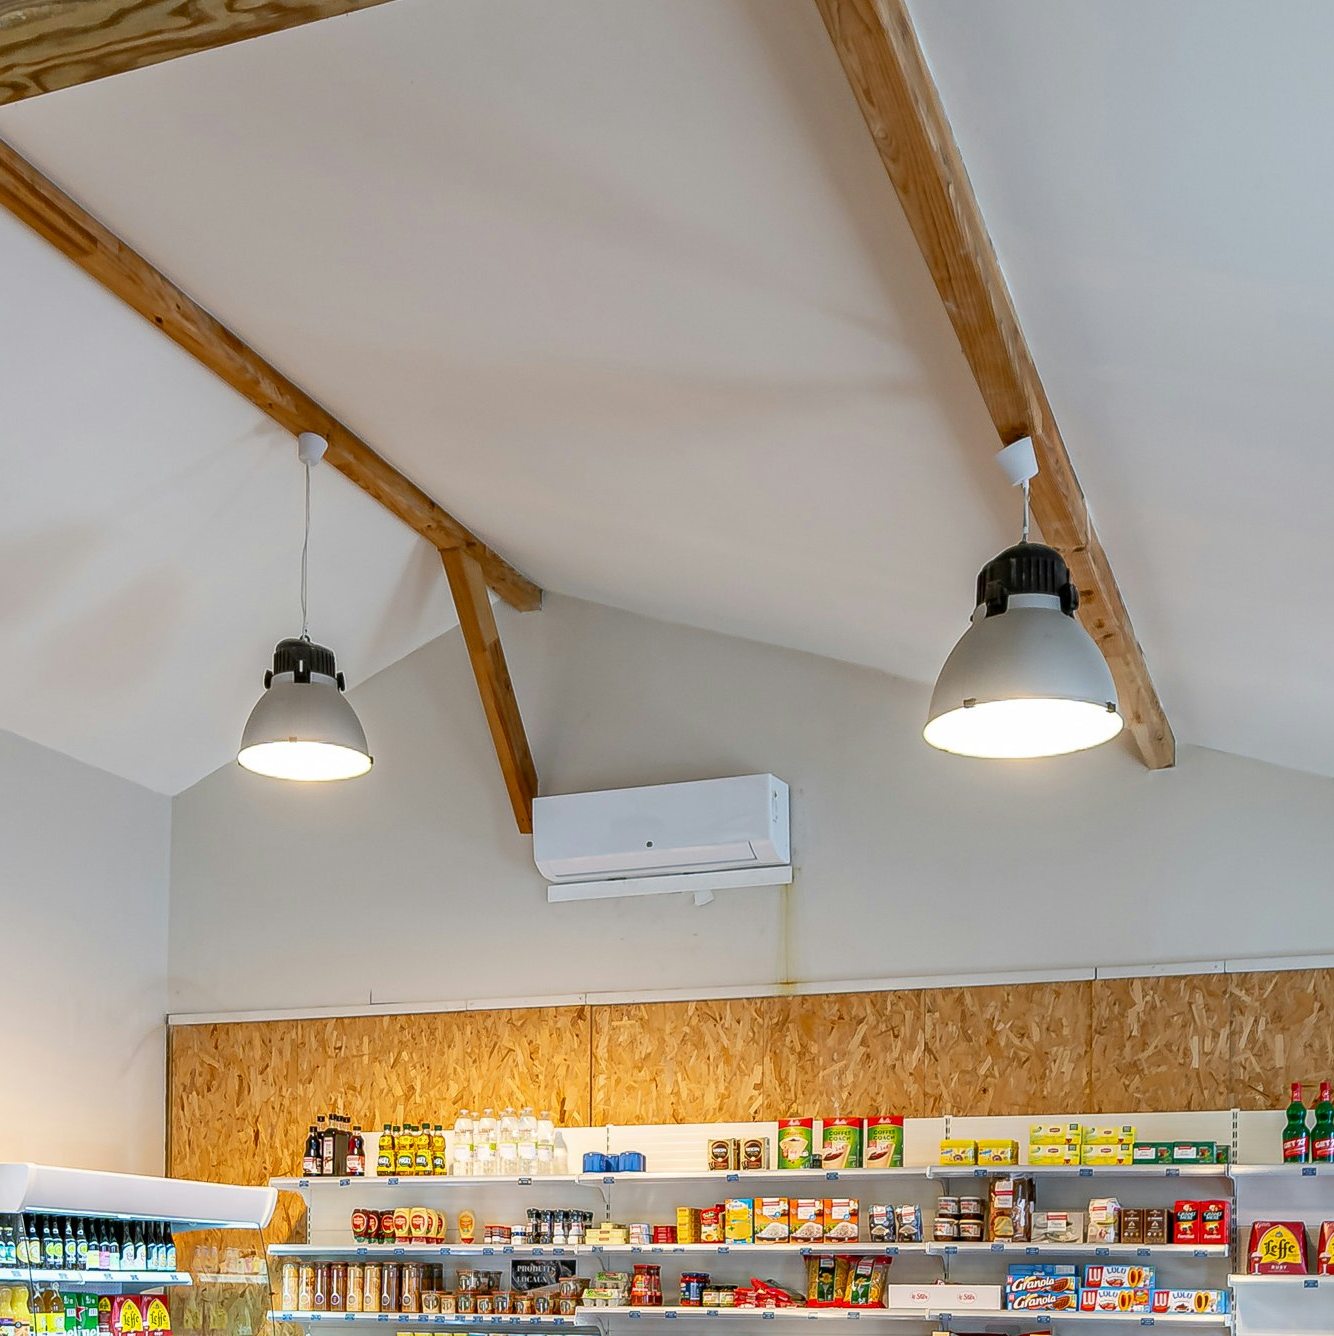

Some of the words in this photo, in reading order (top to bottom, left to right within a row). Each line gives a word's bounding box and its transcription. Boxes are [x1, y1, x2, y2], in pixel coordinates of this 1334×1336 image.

[1264, 1239, 1295, 1259] Leffe
[1088, 1267, 1102, 1281] LU
[1106, 1266, 1127, 1275] LULU
[1011, 1275, 1055, 1293] Granola
[1013, 1290, 1057, 1310] Granola
[1082, 1291, 1096, 1305] LU
[1098, 1289, 1118, 1298] LULU
[1154, 1292, 1169, 1306] LU
[1172, 1291, 1193, 1300] LULU
[122, 1311, 140, 1327] Leffe
[149, 1310, 168, 1326] Leffe
